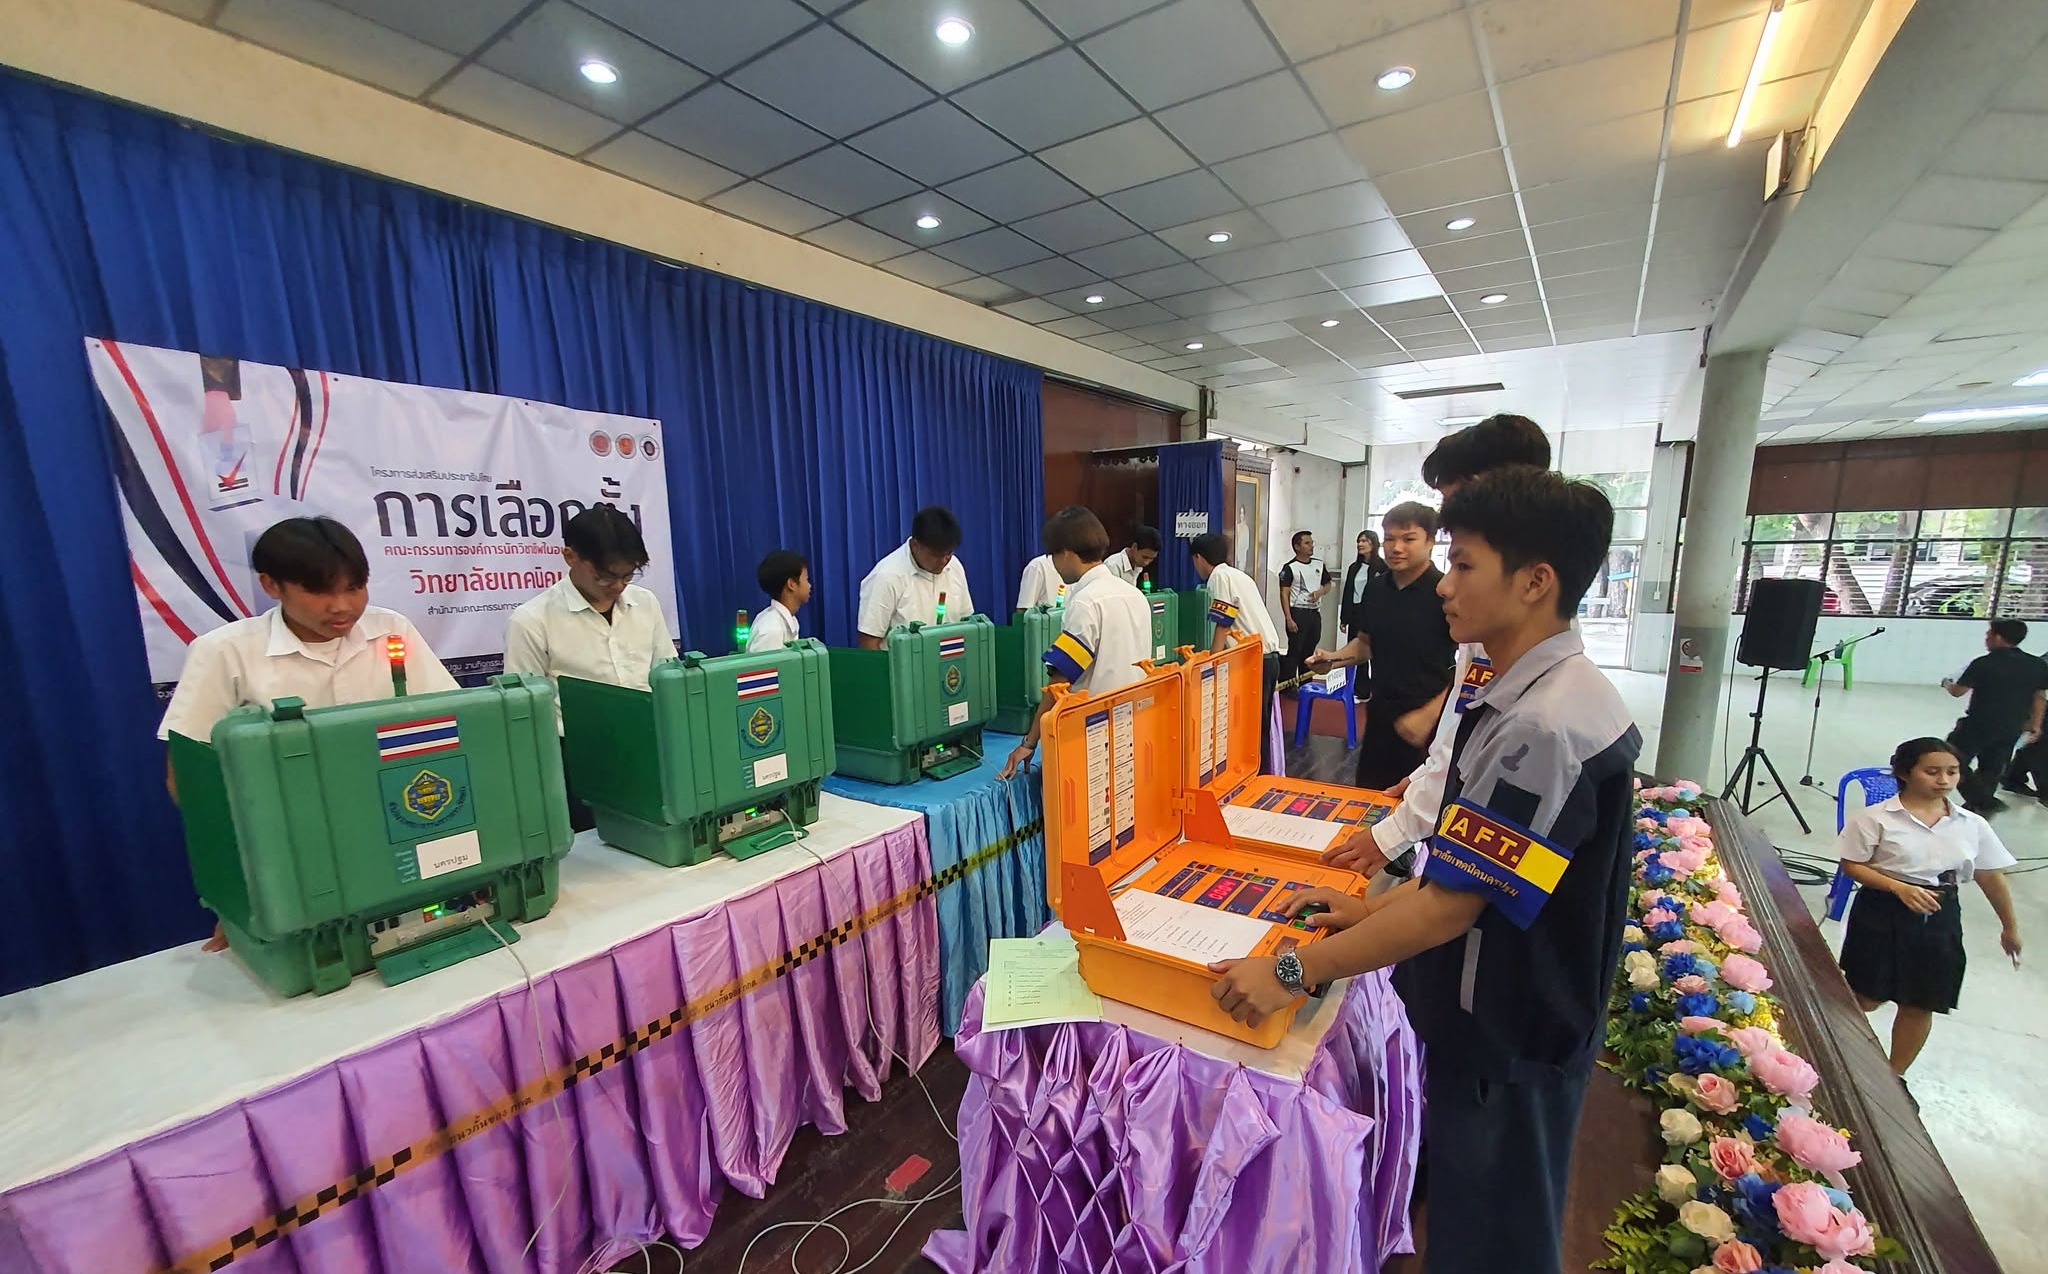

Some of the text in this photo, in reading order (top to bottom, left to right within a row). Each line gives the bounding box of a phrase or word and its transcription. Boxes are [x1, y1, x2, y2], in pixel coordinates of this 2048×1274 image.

[1450, 816, 1520, 865] AFT.
[433, 854, 469, 869] นครปฐม
[449, 1114, 508, 1145] แนวกั้นของ
